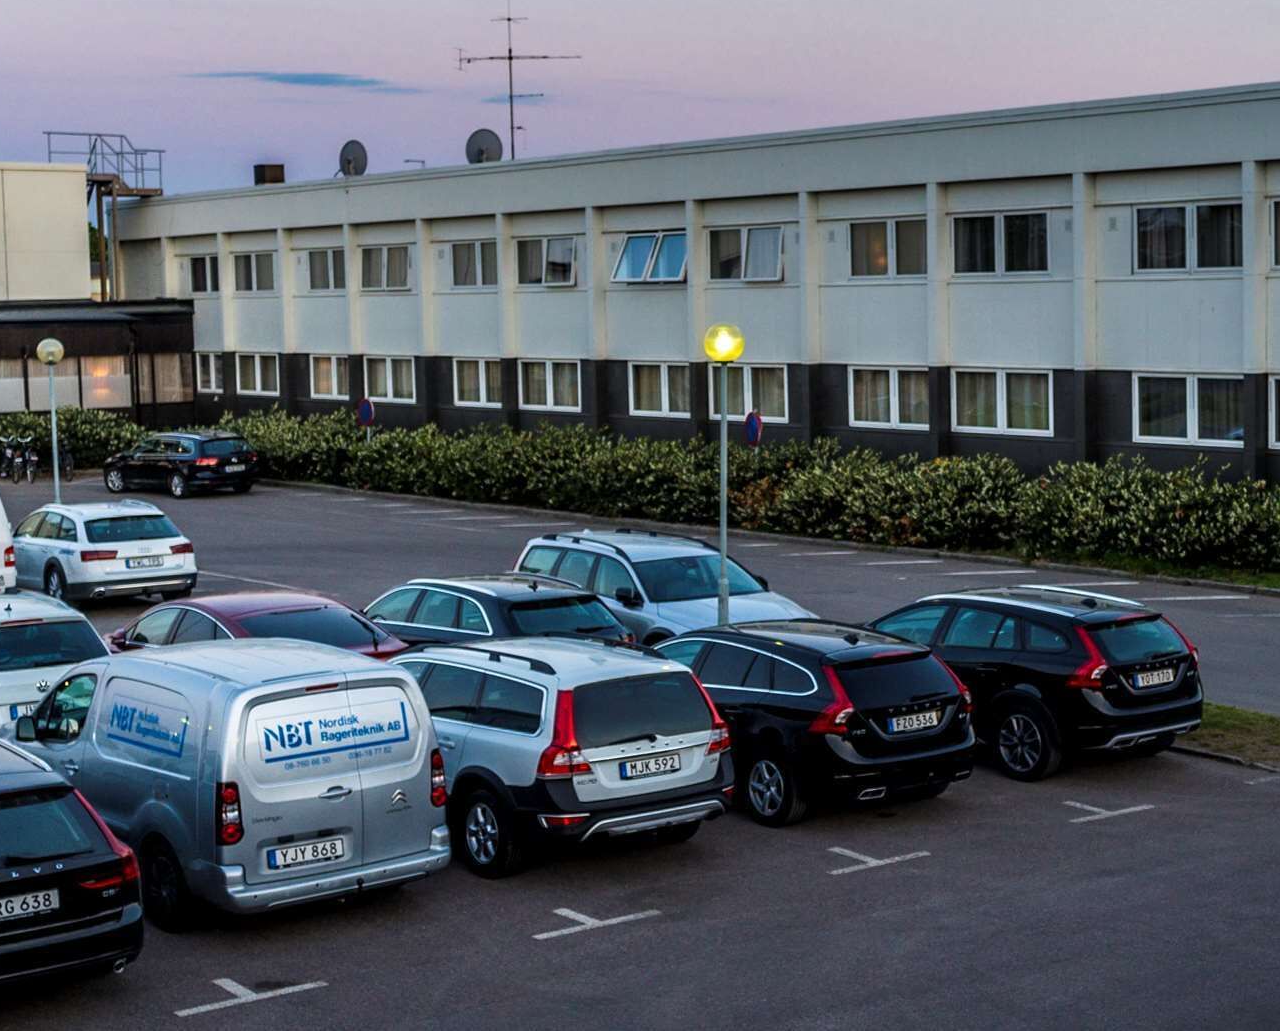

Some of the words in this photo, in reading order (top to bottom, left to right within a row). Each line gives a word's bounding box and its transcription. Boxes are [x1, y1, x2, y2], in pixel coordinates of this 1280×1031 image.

[110, 702, 137, 733] NBT
[319, 714, 359, 729] Nordisk
[917, 714, 934, 726] 536
[264, 720, 313, 752] NBT
[321, 724, 385, 742] Bageriteknik
[388, 720, 401, 731] AB
[630, 761, 653, 775] MJK
[654, 757, 675, 770] 592
[281, 849, 306, 863] YJY
[312, 842, 337, 858] 868
[20, 892, 53, 910] 638
